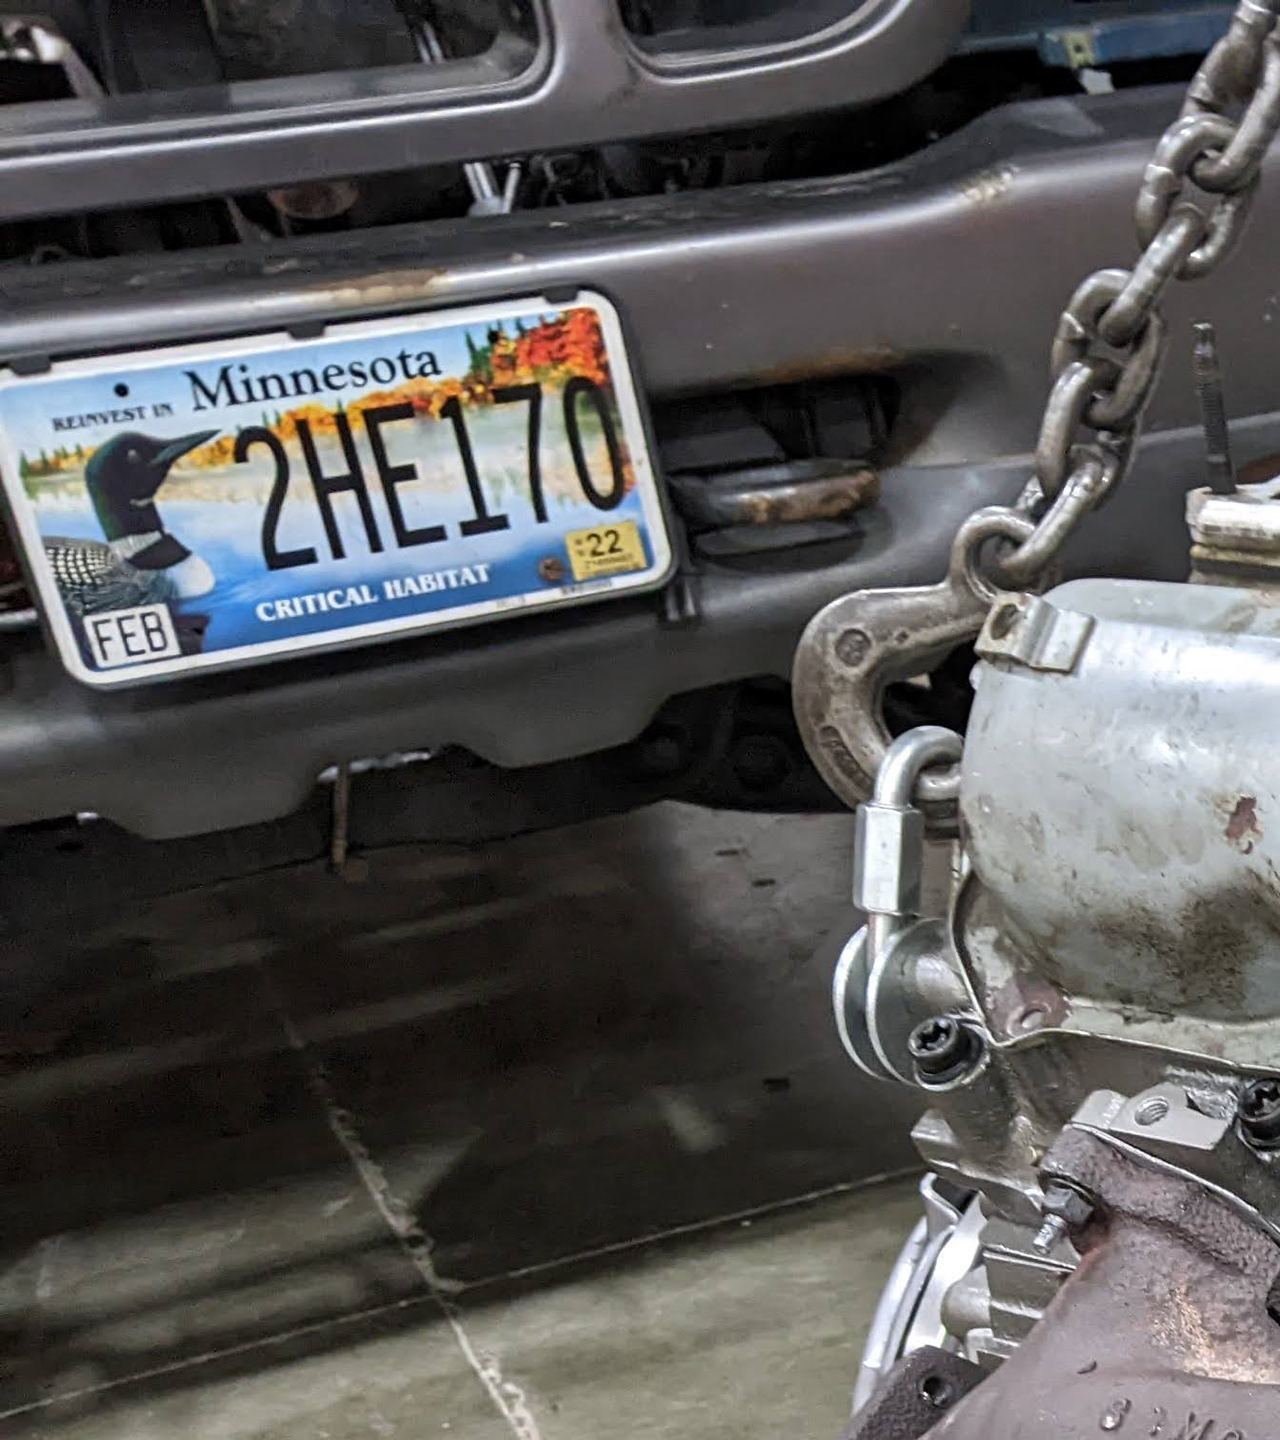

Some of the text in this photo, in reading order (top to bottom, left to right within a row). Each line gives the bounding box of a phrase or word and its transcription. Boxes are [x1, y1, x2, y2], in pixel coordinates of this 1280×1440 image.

[51, 349, 442, 432] REINVEST IN Minnesota
[233, 376, 625, 571] 2HE170
[585, 529, 623, 558] 22
[256, 563, 492, 622] CRITICAL HABITAT
[91, 610, 168, 661] FEB
